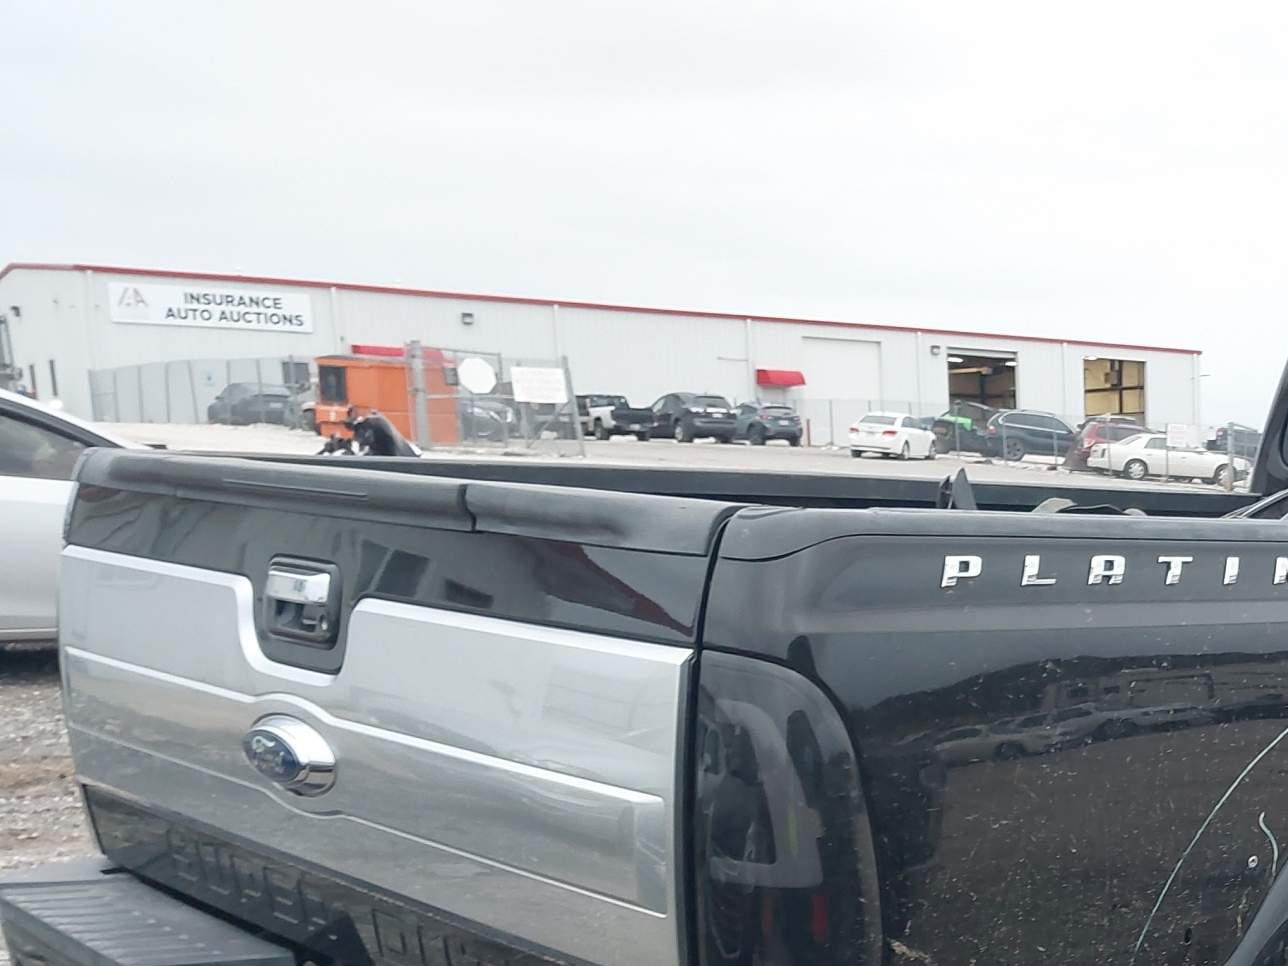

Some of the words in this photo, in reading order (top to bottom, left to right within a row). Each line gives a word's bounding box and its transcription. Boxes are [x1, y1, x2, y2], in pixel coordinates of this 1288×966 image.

[183, 292, 284, 310] INSURANCE
[165, 307, 213, 322] AUTO
[218, 310, 305, 327] AUCTIONS
